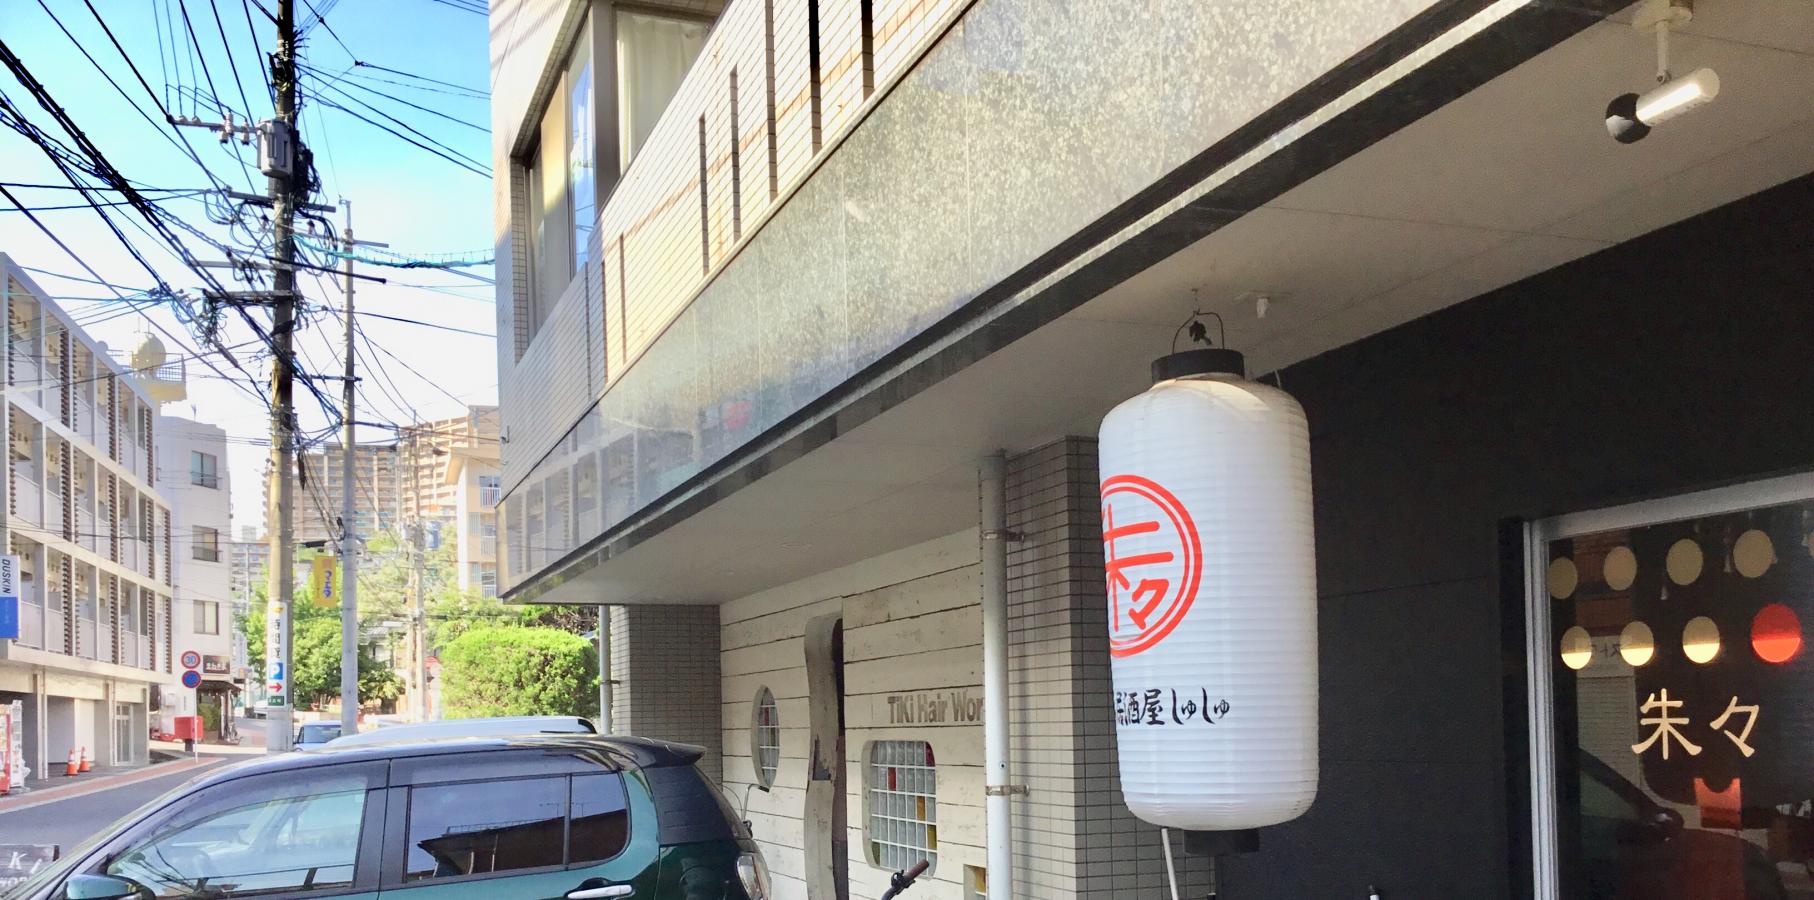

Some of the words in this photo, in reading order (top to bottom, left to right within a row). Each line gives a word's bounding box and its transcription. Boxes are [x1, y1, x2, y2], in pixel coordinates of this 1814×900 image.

[2, 559, 11, 593] DUSKIN
[185, 656, 196, 664] 30
[917, 693, 947, 722] Hair
[1632, 688, 1759, 760] 朱々
